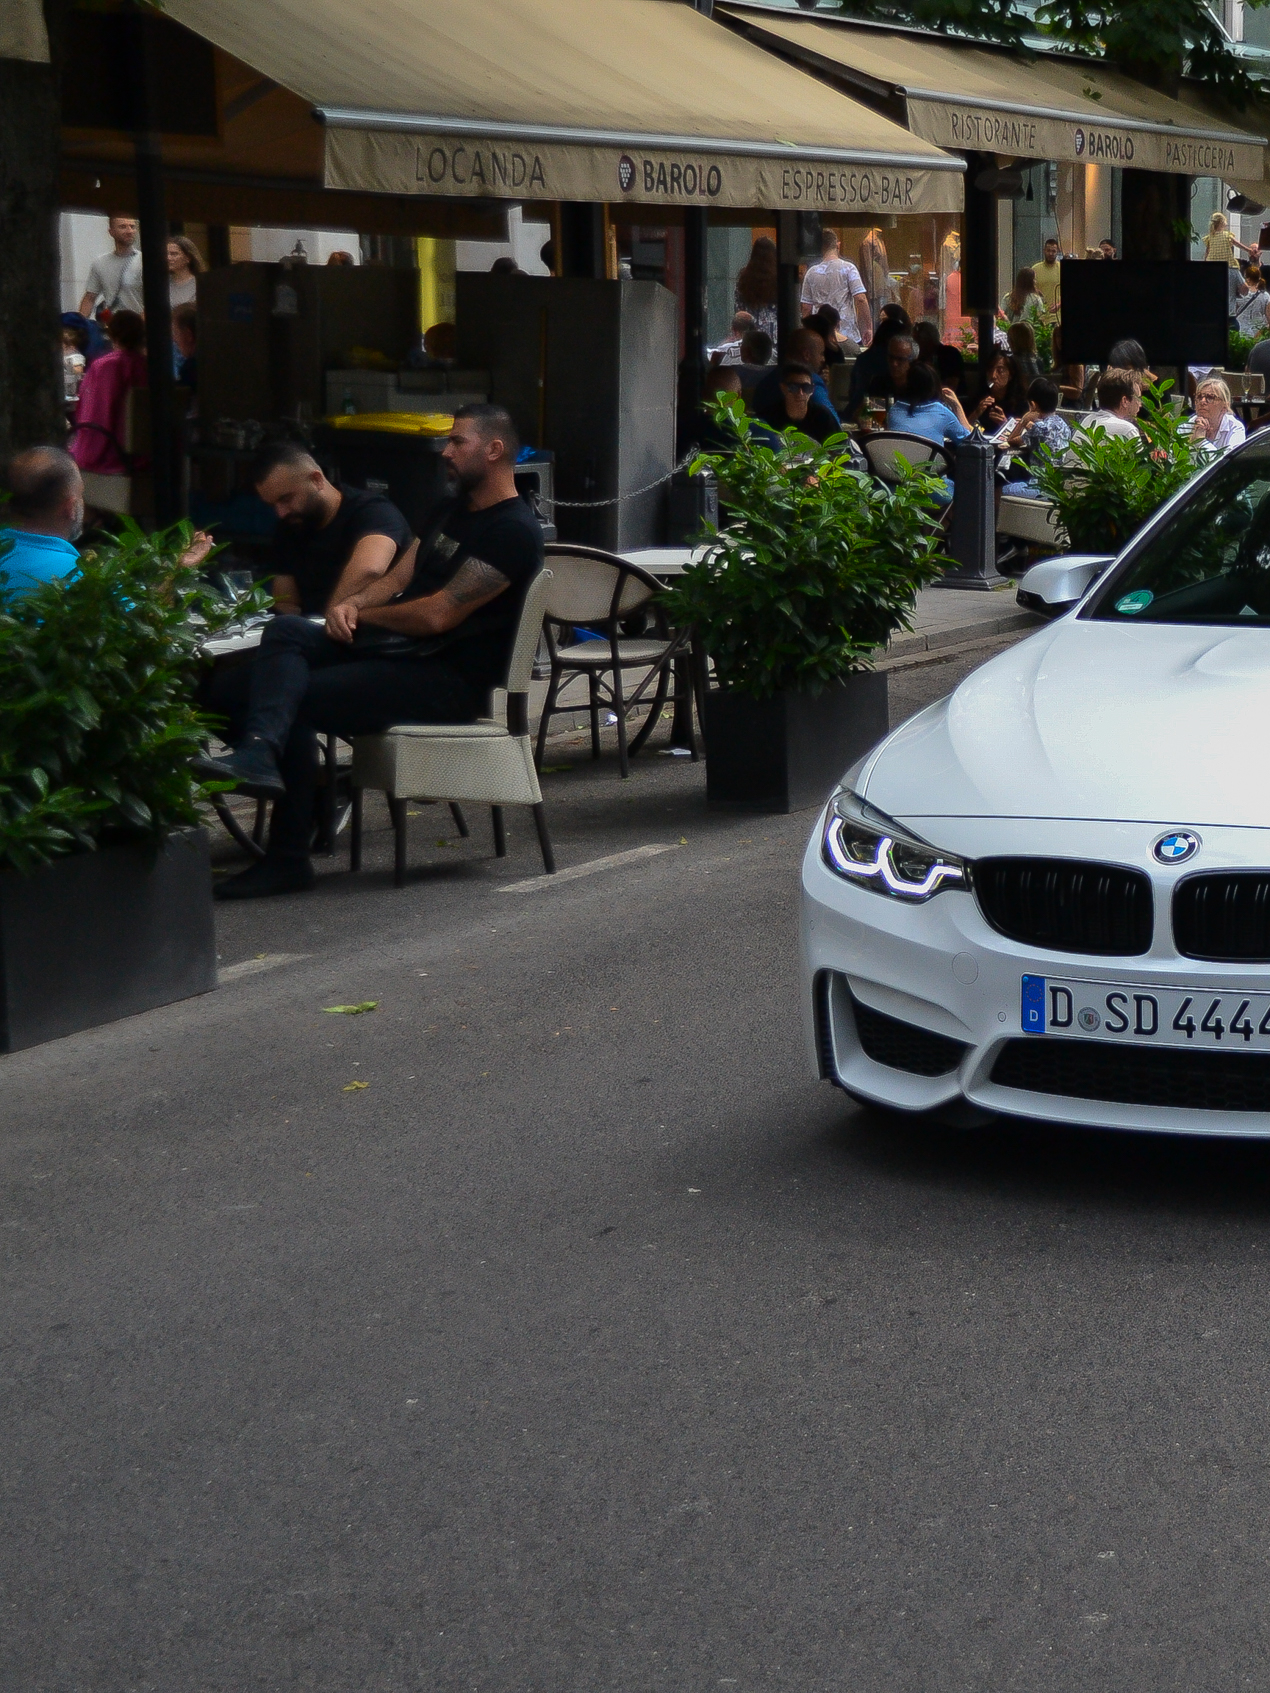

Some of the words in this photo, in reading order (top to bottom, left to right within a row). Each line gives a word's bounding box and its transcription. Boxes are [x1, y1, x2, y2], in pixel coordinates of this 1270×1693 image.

[950, 112, 1037, 150] RISTORANTE
[1087, 132, 1135, 161] BAROLO
[1165, 141, 1236, 172] PASTICCERIA
[415, 147, 546, 190] LOCANDA
[643, 159, 722, 197] BAROLO
[782, 169, 914, 205] ESPRESSO-BAR
[1029, 1009, 1039, 1022] D
[1049, 985, 1073, 1028] D
[1104, 991, 1159, 1036] SD
